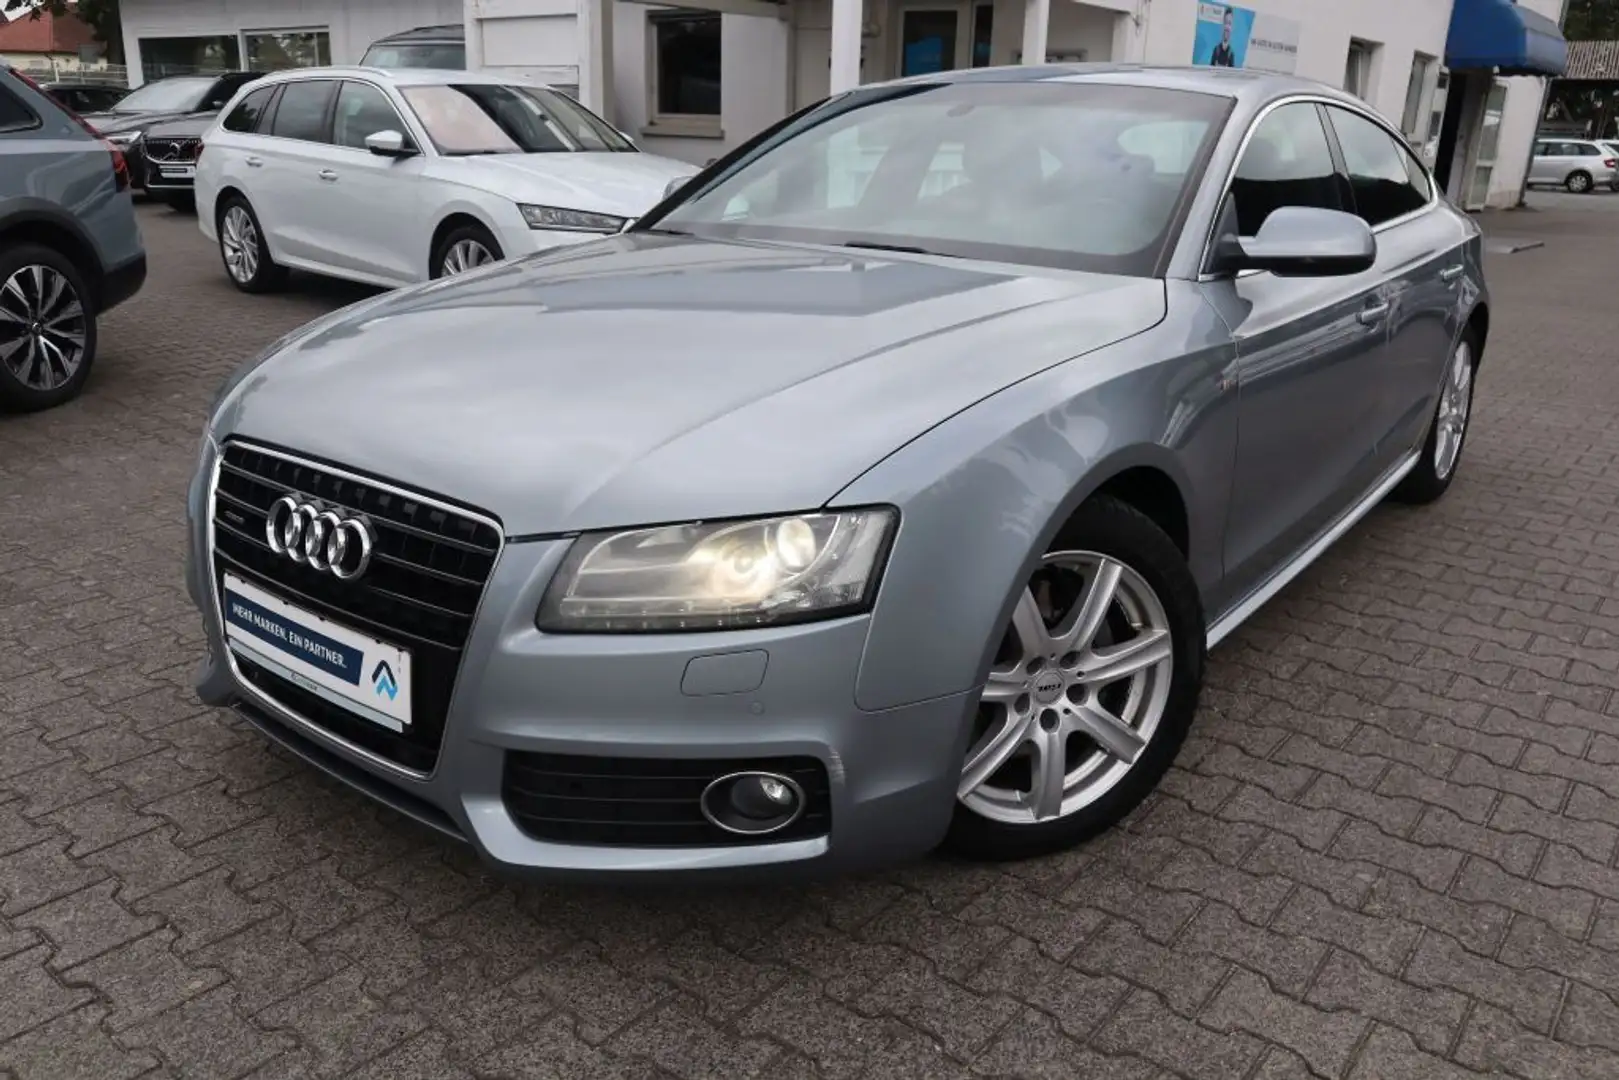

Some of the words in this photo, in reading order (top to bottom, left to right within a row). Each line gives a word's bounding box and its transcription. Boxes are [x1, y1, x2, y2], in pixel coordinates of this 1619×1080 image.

[232, 602, 253, 623] MEHR
[253, 613, 288, 642] MARKEN.
[289, 631, 303, 649] EIN
[303, 638, 348, 669] PARTNER.
